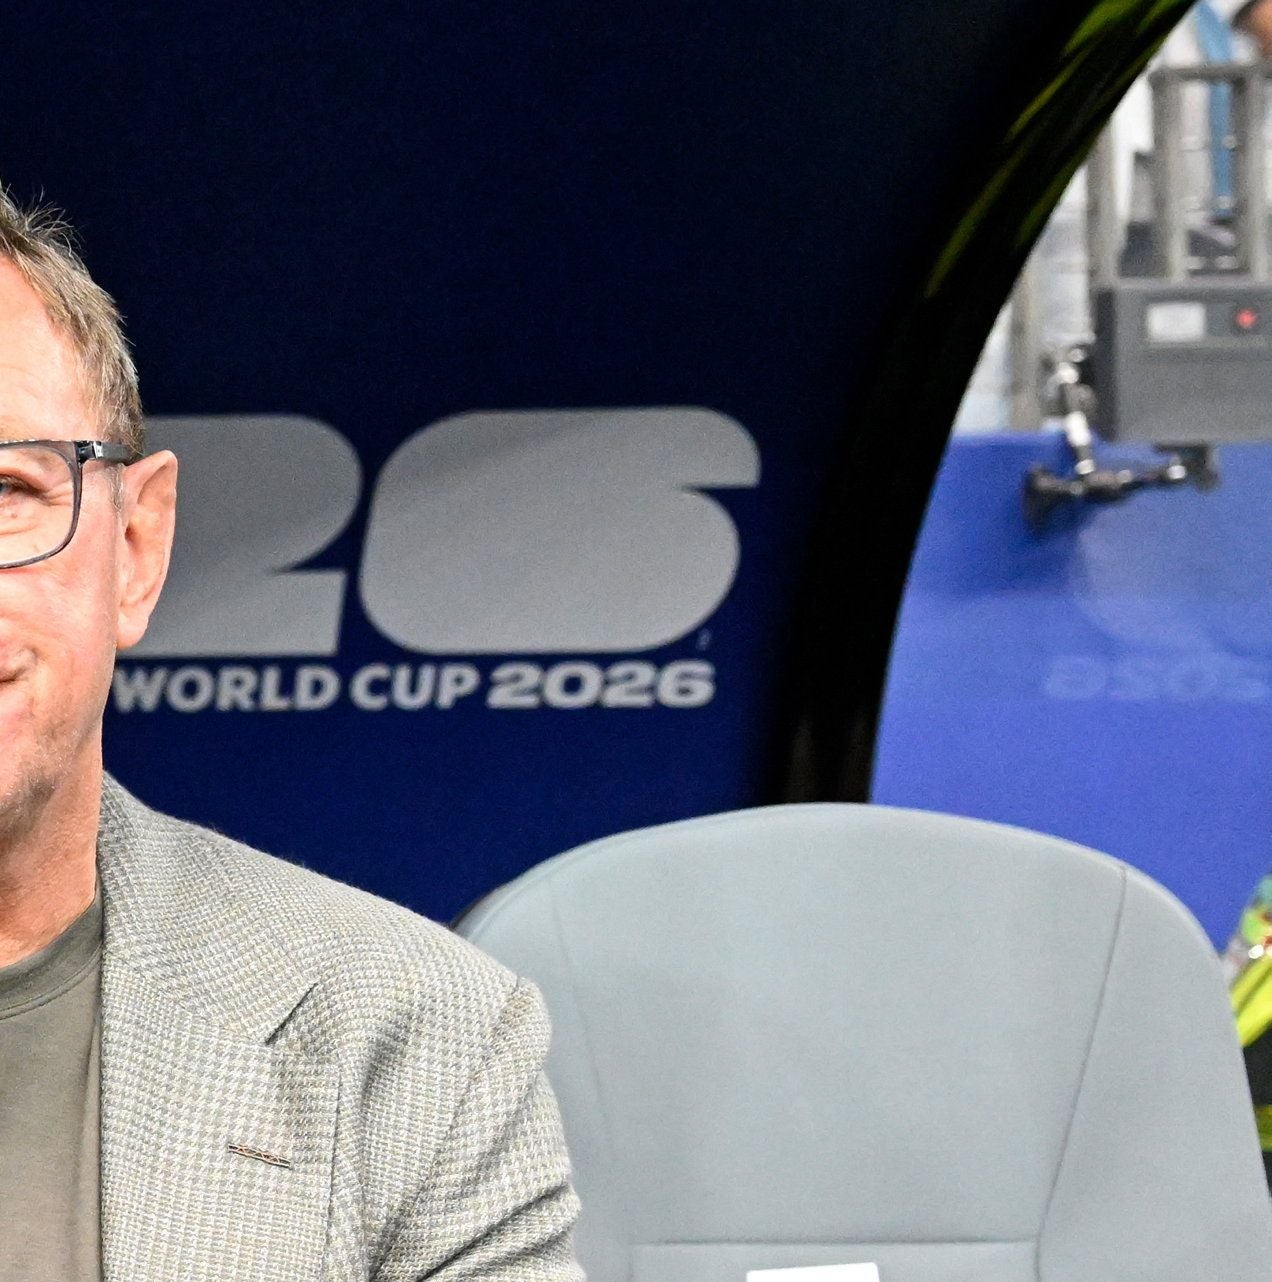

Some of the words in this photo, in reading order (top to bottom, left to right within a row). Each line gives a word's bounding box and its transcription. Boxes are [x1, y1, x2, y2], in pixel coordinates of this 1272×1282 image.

[113, 664, 340, 713] WORLD
[349, 663, 479, 711] CUP
[486, 659, 716, 709] 2026
